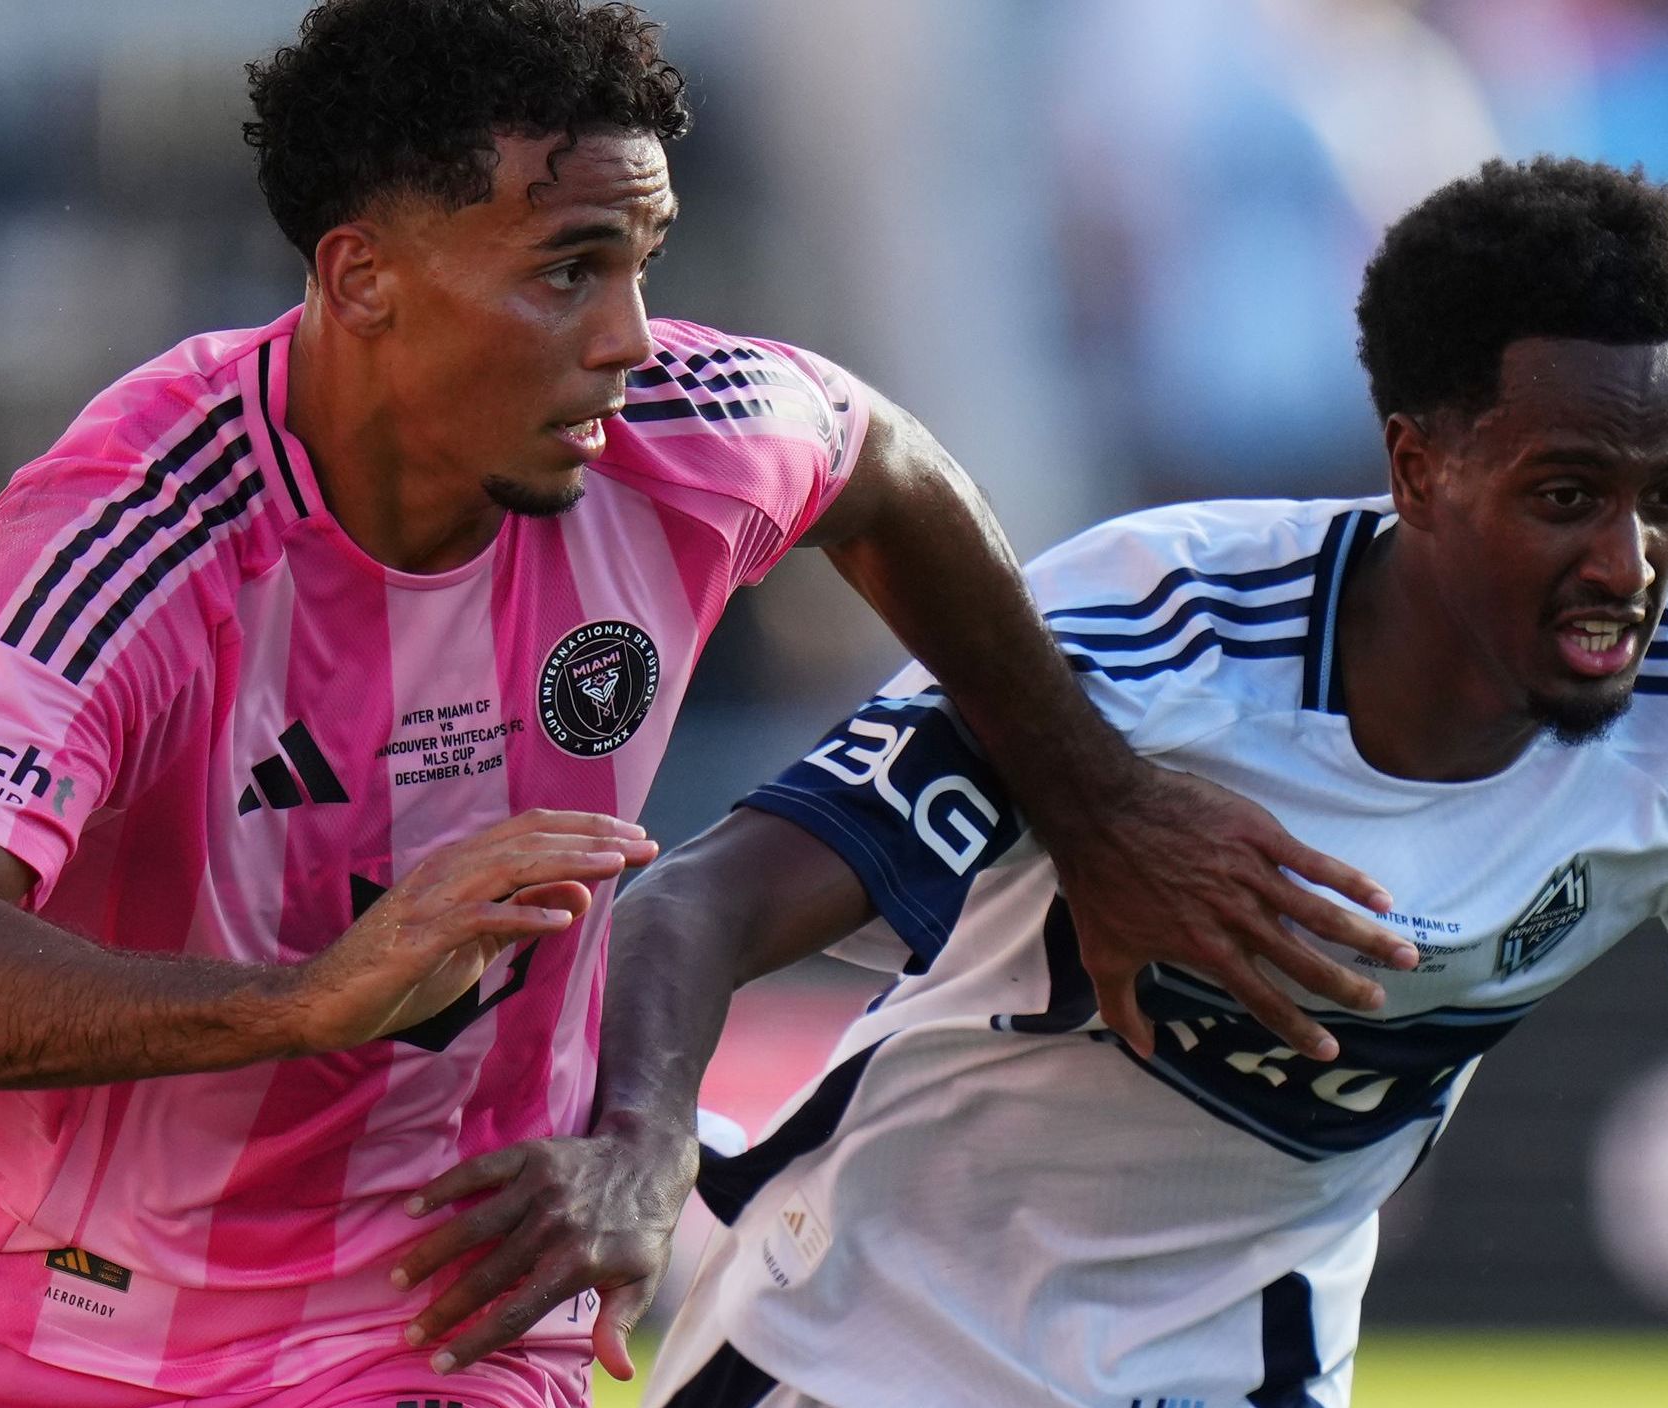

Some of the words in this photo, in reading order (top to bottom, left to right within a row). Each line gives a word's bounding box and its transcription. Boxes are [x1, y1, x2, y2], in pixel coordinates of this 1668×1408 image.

[633, 633, 648, 649] DE
[543, 625, 630, 703] INTERNACIONAL
[572, 651, 621, 679] MIAMI
[401, 709, 434, 726] INTER
[437, 703, 473, 720] MIAMI
[476, 699, 491, 713] CF
[545, 711, 567, 741] CLUB
[441, 723, 508, 748] WHITECAPS
[510, 719, 525, 734] FC
[593, 728, 630, 752] MMXX
[395, 765, 460, 786] DECEMBER
[463, 763, 475, 776] 6,
[478, 755, 503, 774] 2025
[423, 751, 449, 766] MLS
[452, 747, 476, 761] CUP
[803, 718, 1000, 877] BLG
[1412, 917, 1446, 932] MIAMI
[1448, 922, 1462, 934] CF
[44, 1286, 115, 1318] AEROREADY
